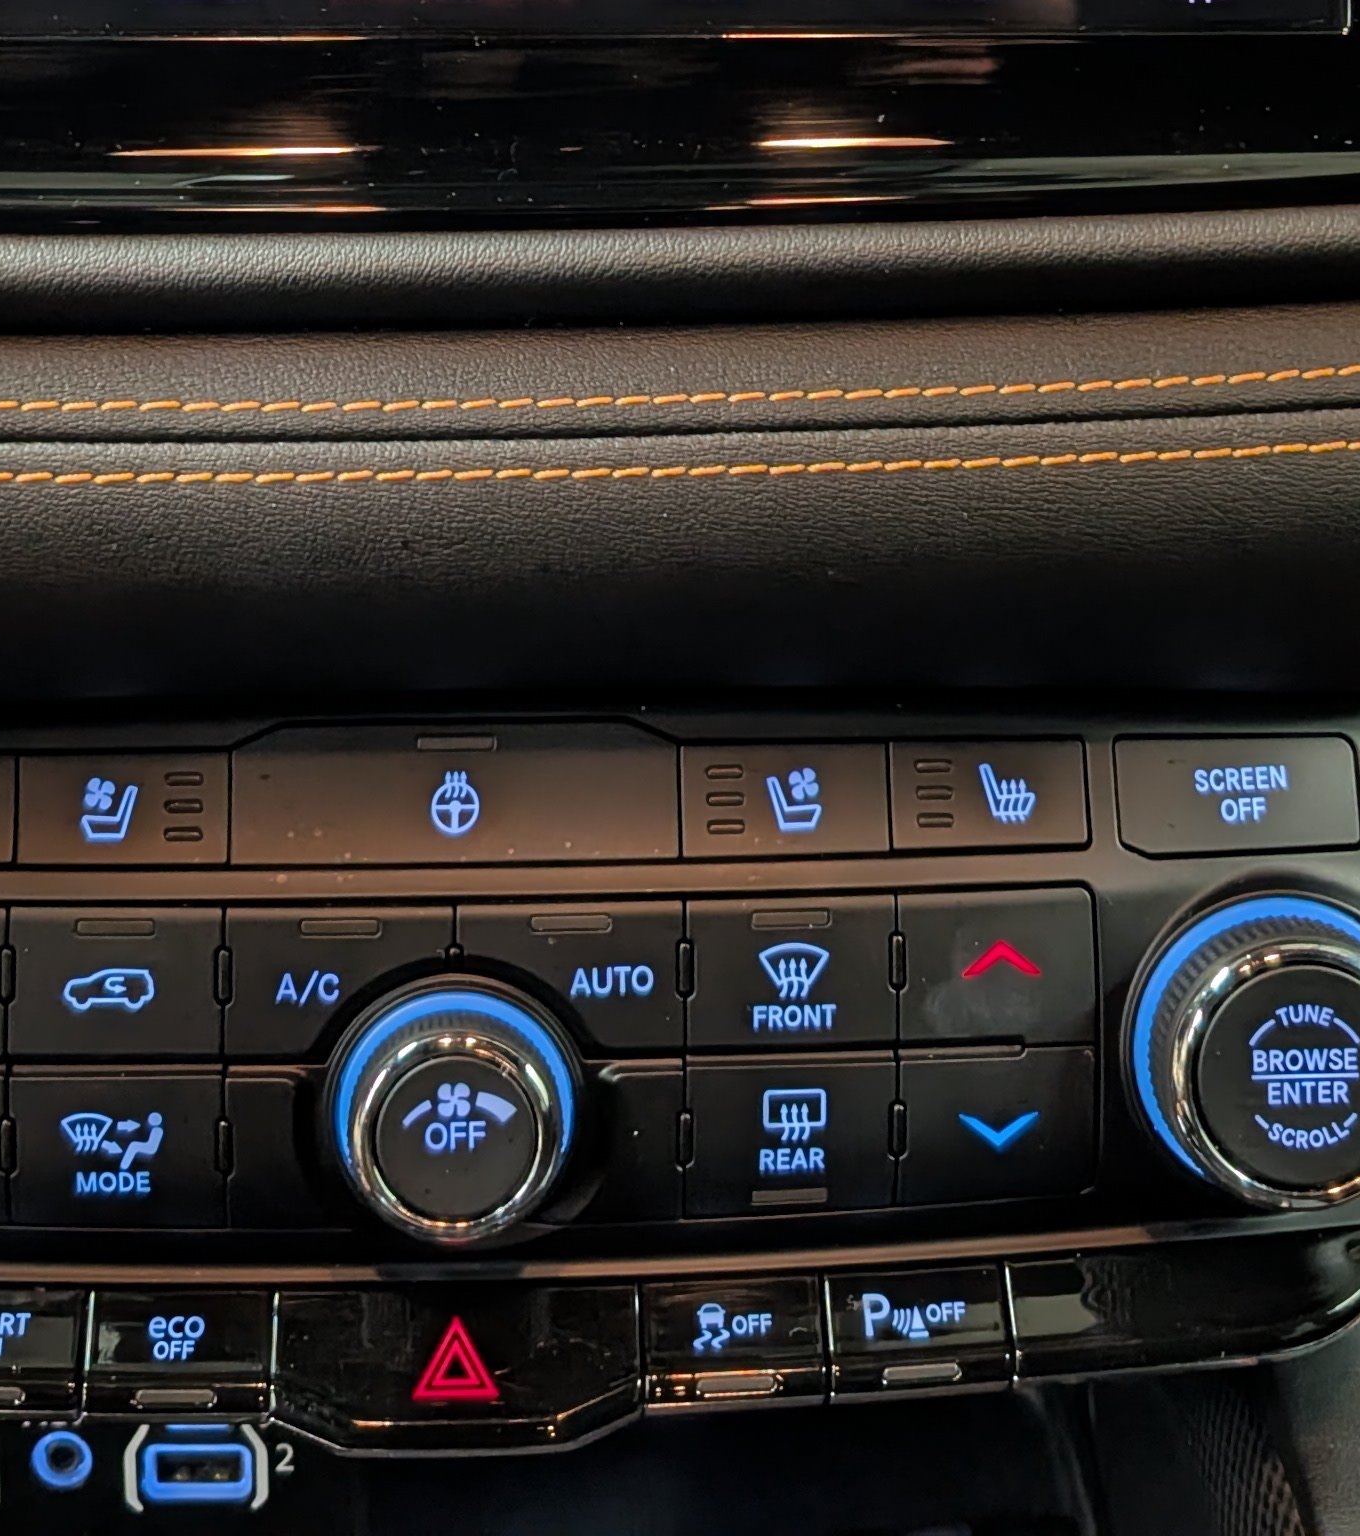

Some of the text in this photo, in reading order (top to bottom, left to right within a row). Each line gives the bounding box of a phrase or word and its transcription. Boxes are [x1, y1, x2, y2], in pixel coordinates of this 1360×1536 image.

[1192, 765, 1289, 793] SCREEN
[1219, 796, 1268, 824] OFF
[275, 969, 341, 1006] A/C
[569, 965, 655, 997] AUTO
[751, 1001, 838, 1031] FRONT
[1274, 1005, 1334, 1029] TUNE
[1252, 1047, 1359, 1074] BROWSE
[1266, 1079, 1351, 1108] ENTER
[423, 1120, 488, 1151] OFF
[1265, 1122, 1350, 1151] SCROLL
[758, 1145, 826, 1173] REAR
[75, 1170, 152, 1196] MODE
[147, 1314, 206, 1339] eco
[731, 1311, 773, 1338] OFF
[925, 1299, 967, 1326] OFF
[152, 1341, 196, 1361] OFF
[274, 1443, 295, 1473] 2
